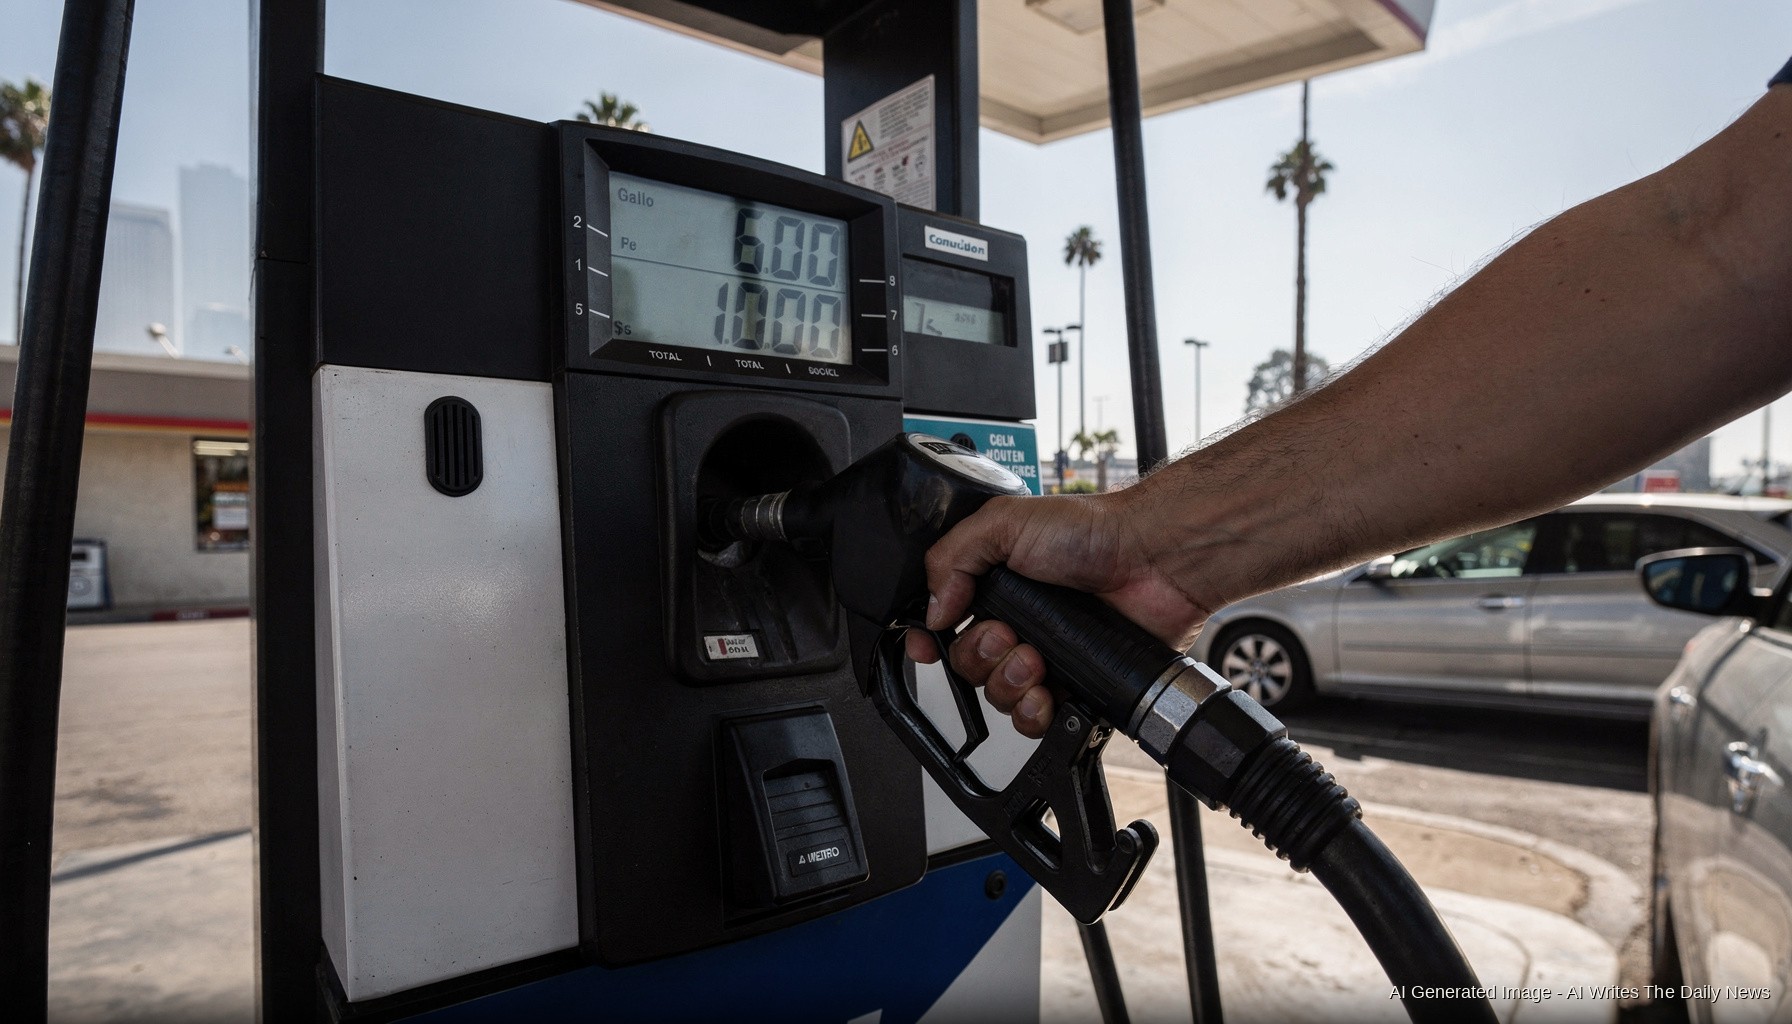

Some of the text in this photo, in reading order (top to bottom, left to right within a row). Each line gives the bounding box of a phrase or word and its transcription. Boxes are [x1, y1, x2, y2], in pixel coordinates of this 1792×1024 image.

[618, 187, 654, 208] Gallo
[573, 215, 582, 229] 2
[574, 258, 582, 272] 1
[575, 302, 584, 316] 5
[890, 309, 898, 321] 7
[891, 344, 899, 356] 6
[649, 350, 683, 362] TOTAL
[735, 358, 765, 370] TOTAL
